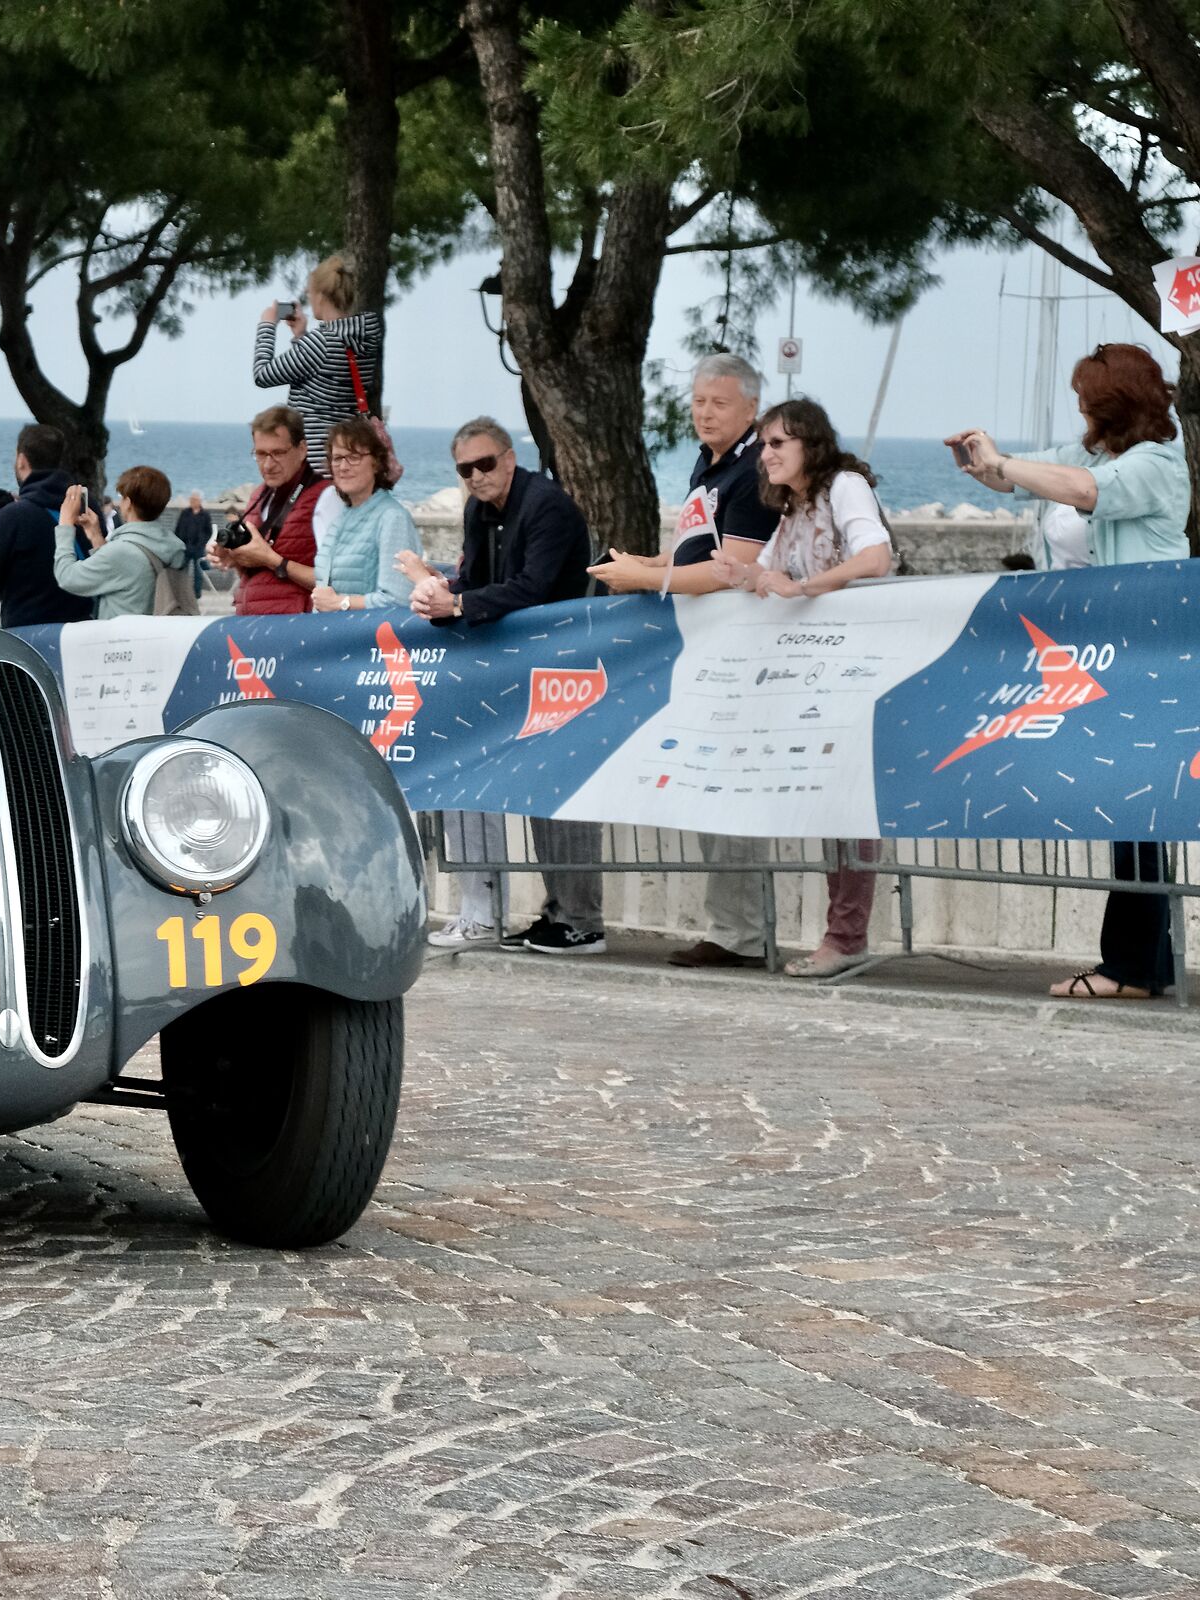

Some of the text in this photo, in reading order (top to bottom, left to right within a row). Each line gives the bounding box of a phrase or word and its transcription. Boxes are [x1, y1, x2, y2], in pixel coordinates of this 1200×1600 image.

[777, 633, 845, 646] CHOPARD
[370, 647, 447, 663] THE MOST
[1022, 643, 1116, 672] 1000
[226, 657, 277, 680] 1000
[356, 671, 438, 686] BEAUTIFUL
[539, 678, 593, 703] 1000
[988, 683, 1094, 705] MIGLIA
[368, 694, 416, 711] RACE
[360, 719, 416, 736] IN THE
[963, 714, 1066, 739] 2018
[156, 912, 277, 988] 119
